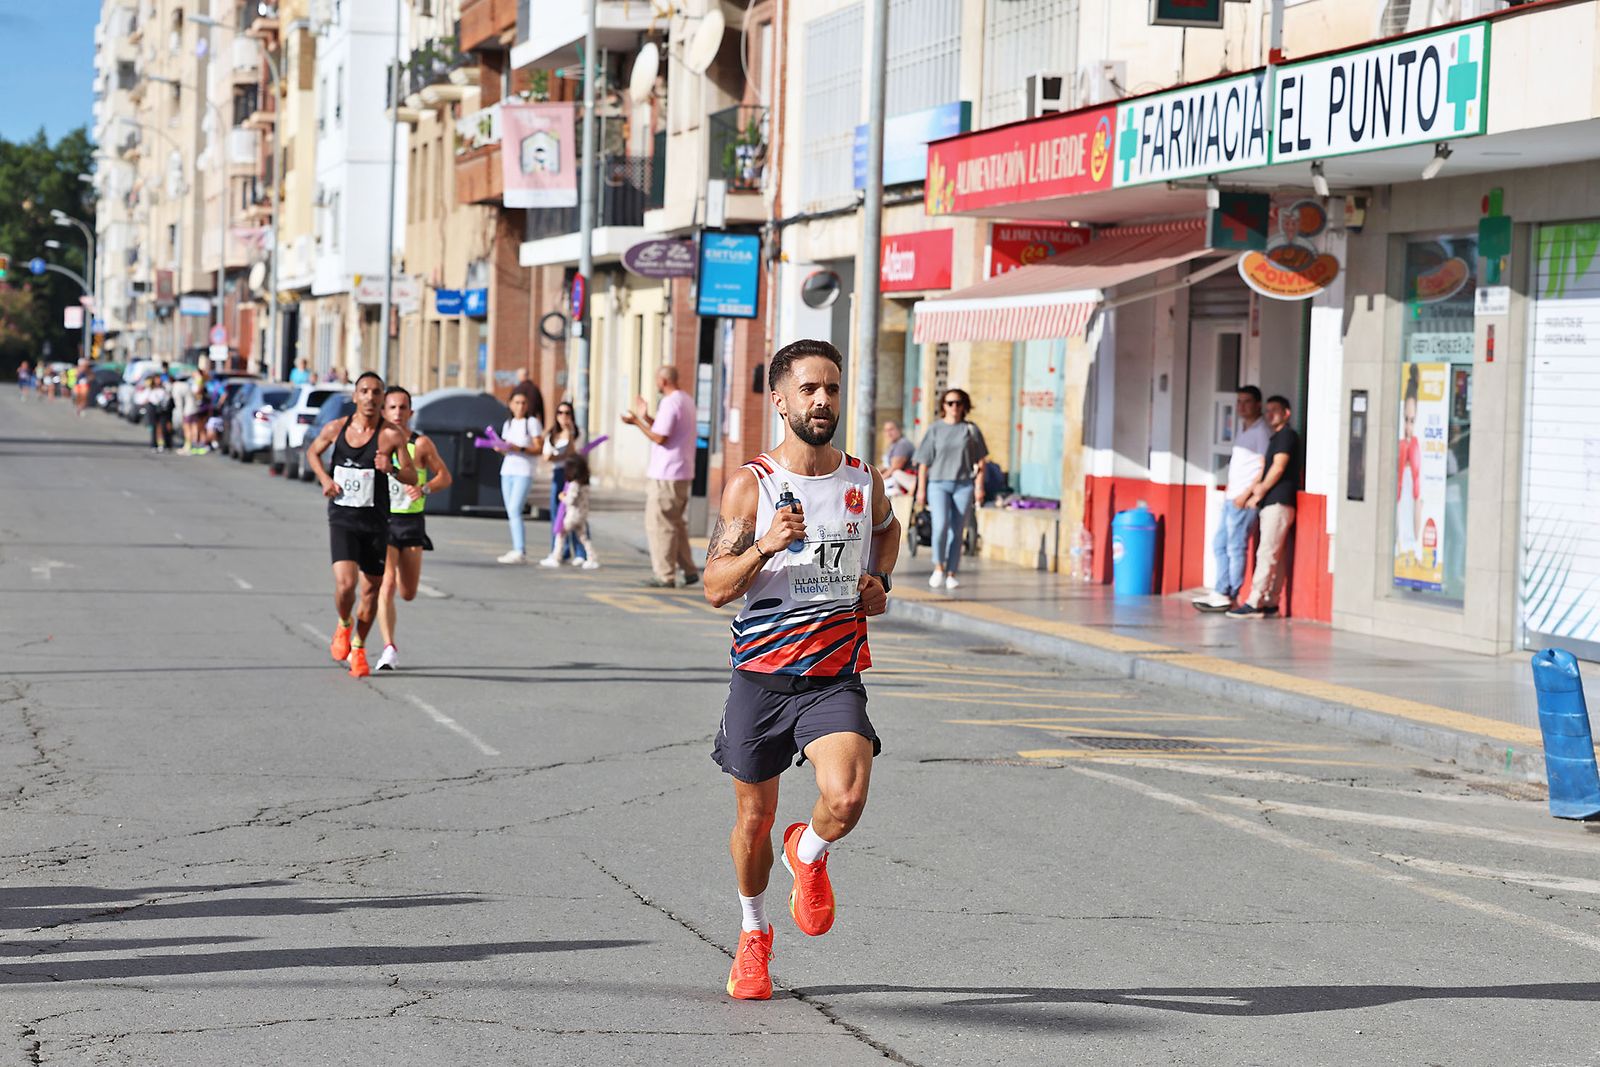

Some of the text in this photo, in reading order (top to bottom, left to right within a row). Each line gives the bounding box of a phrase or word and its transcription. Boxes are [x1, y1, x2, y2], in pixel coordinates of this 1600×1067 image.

[1139, 45, 1441, 175] FARMACIA EL PUNTO
[344, 478, 361, 492] 69
[389, 483, 400, 496] 9
[845, 521, 860, 535] 2K
[814, 542, 846, 569] 17
[795, 576, 819, 586] ILLAN
[820, 575, 829, 584] DE
[829, 575, 841, 583] LA
[794, 583, 830, 594] Huelva
